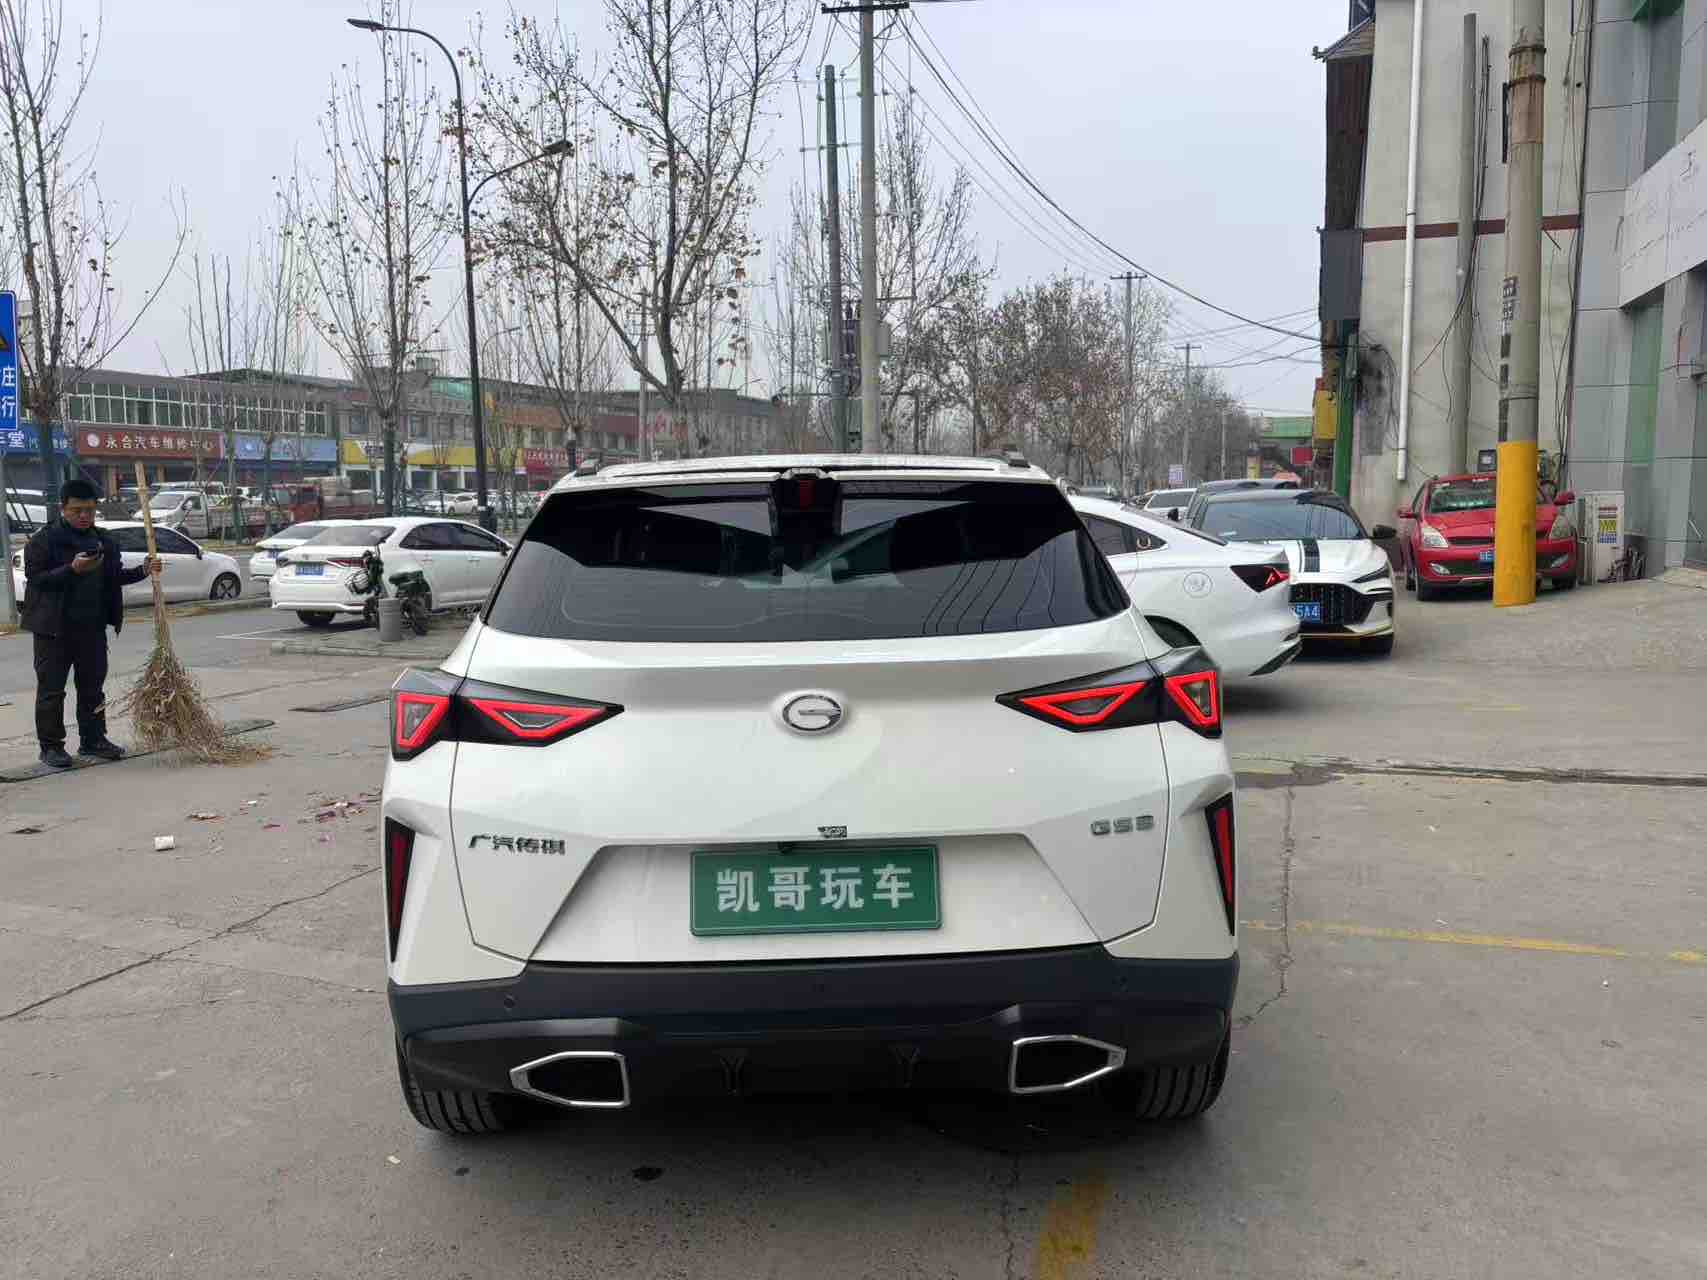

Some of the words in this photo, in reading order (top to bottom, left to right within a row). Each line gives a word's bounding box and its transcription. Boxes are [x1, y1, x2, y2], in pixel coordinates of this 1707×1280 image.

[468, 834, 566, 856] 广汽传祺
[715, 862, 915, 913] 凯哥玩车
